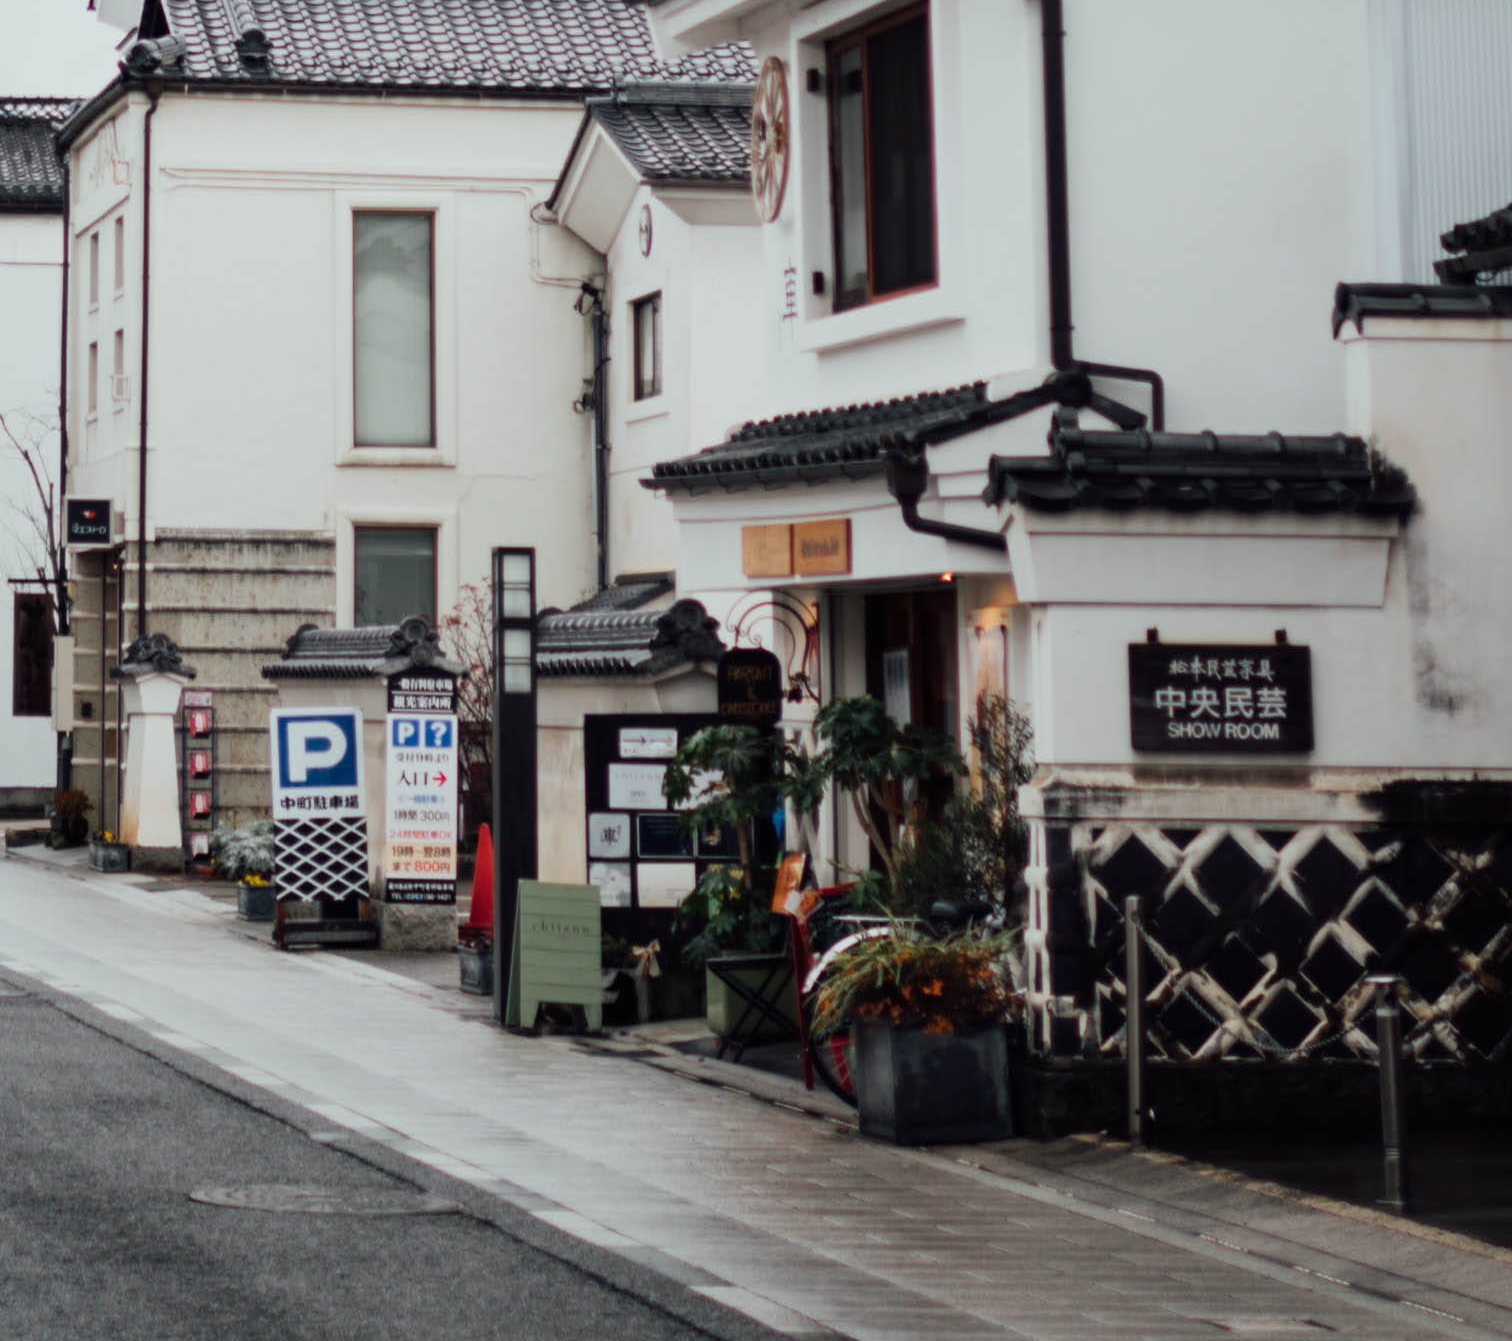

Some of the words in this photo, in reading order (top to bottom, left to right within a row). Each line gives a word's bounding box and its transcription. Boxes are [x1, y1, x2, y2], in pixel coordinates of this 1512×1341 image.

[1154, 685, 1287, 718] 中央民芸
[1167, 722, 1222, 739] SHOW
[1226, 722, 1280, 740] ROOM
[286, 719, 348, 784] P
[399, 771, 428, 786] 入口
[279, 795, 360, 811] 中町駐車場
